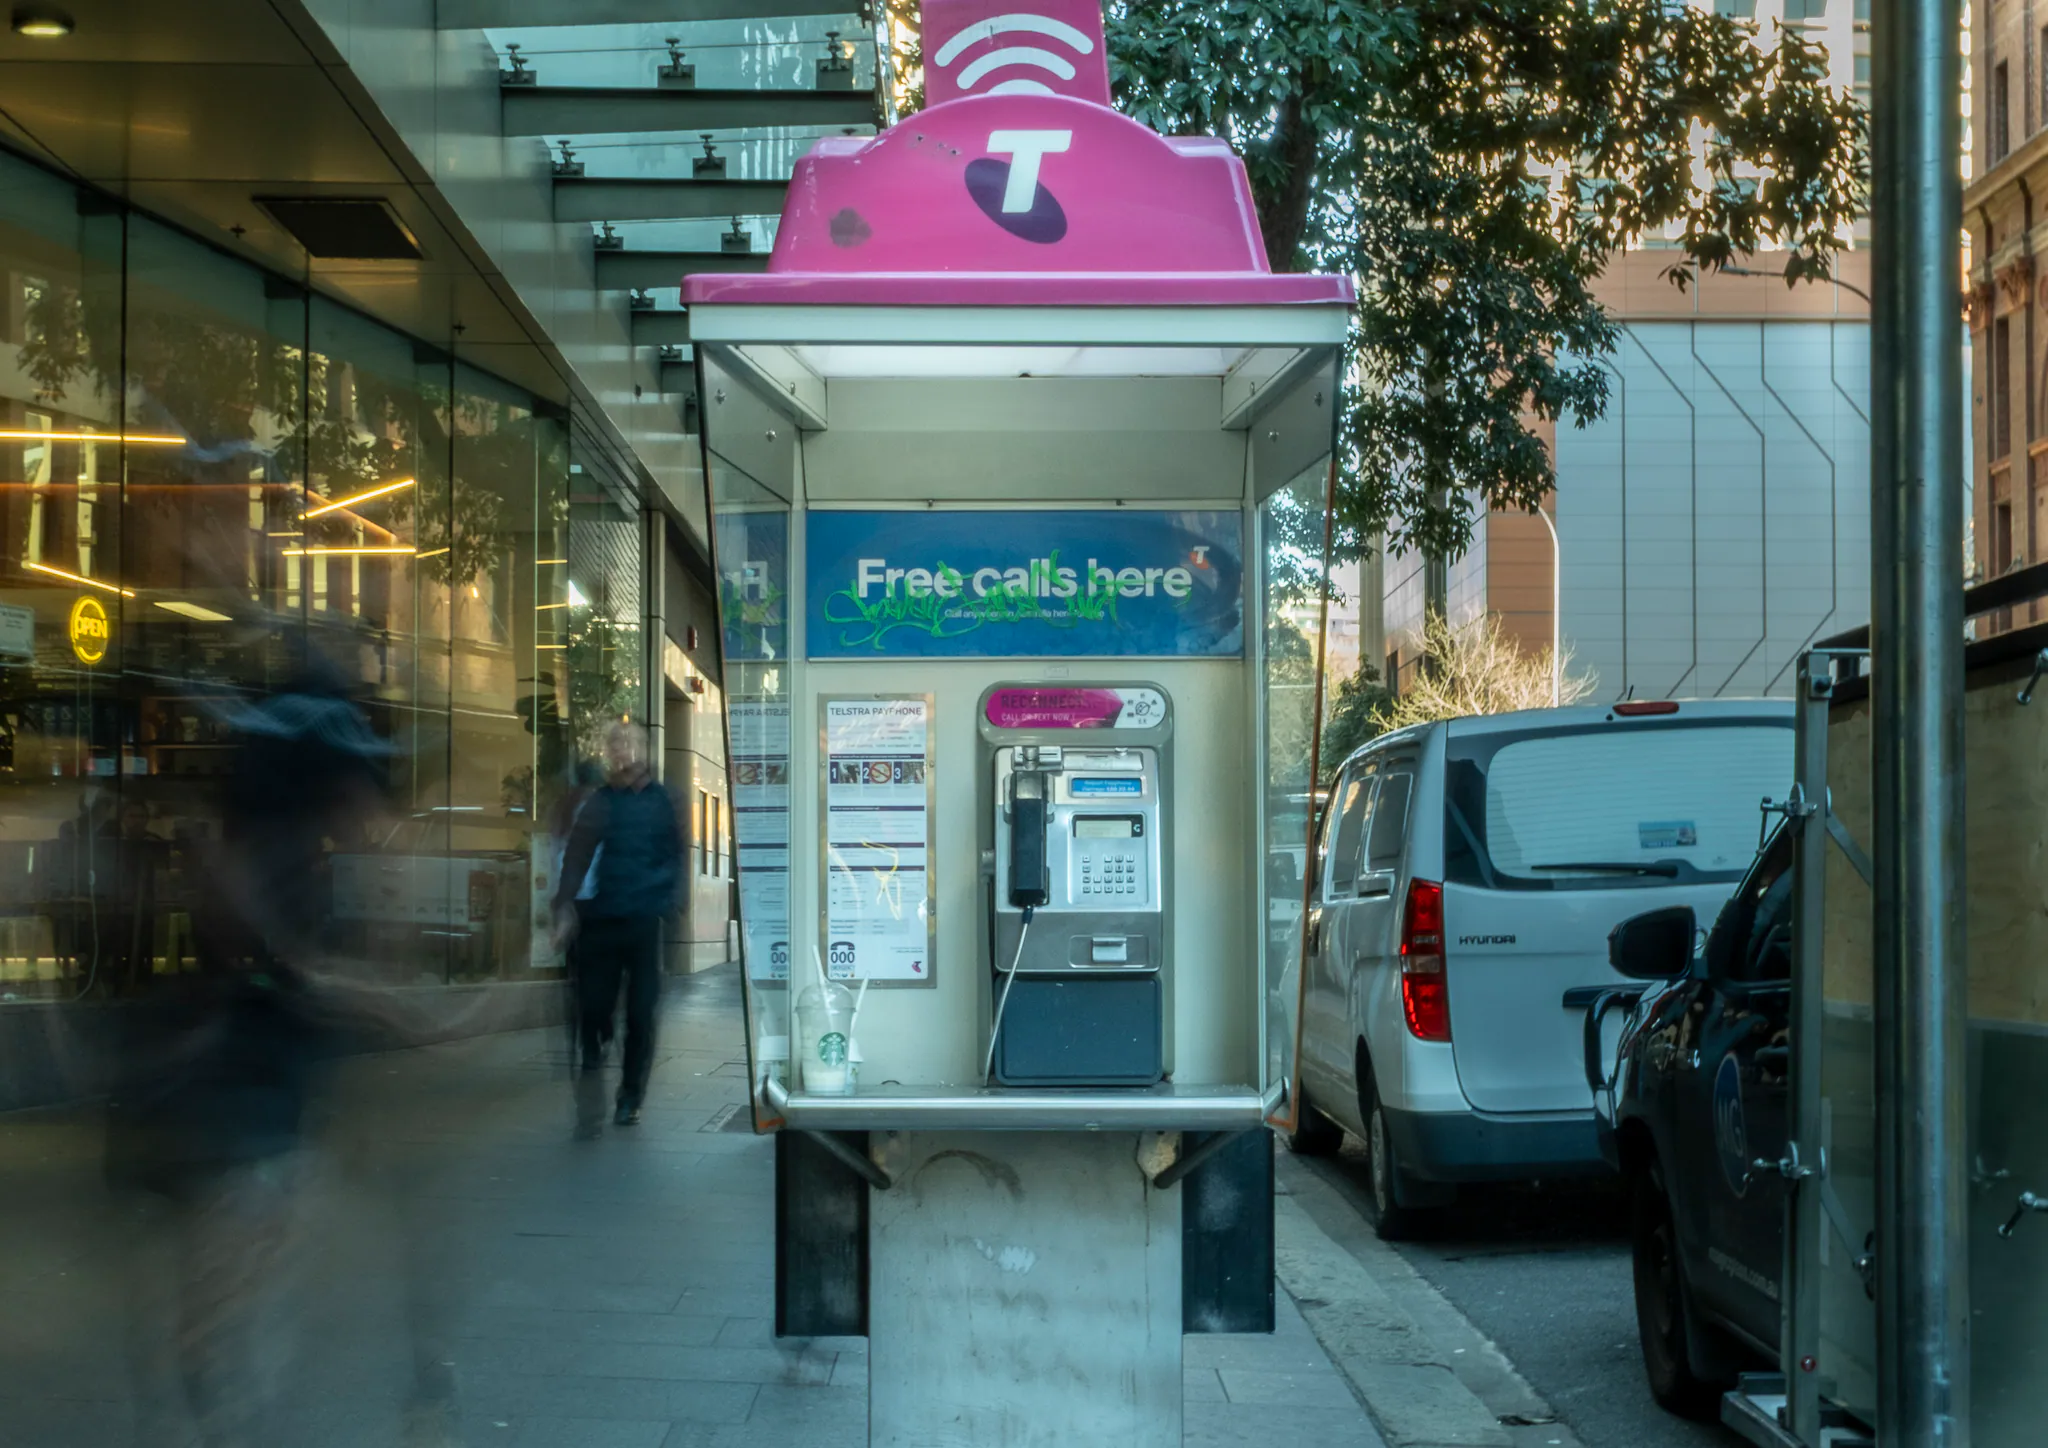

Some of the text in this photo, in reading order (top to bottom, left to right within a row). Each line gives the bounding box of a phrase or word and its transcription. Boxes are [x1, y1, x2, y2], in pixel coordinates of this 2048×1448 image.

[986, 129, 1073, 214] T
[857, 558, 1193, 599] Free calls here
[74, 616, 108, 640] OPEN
[829, 706, 922, 717] TELSTRA PAYPHONE
[1459, 933, 1516, 945] HYUNDAI
[830, 951, 855, 964] 000
